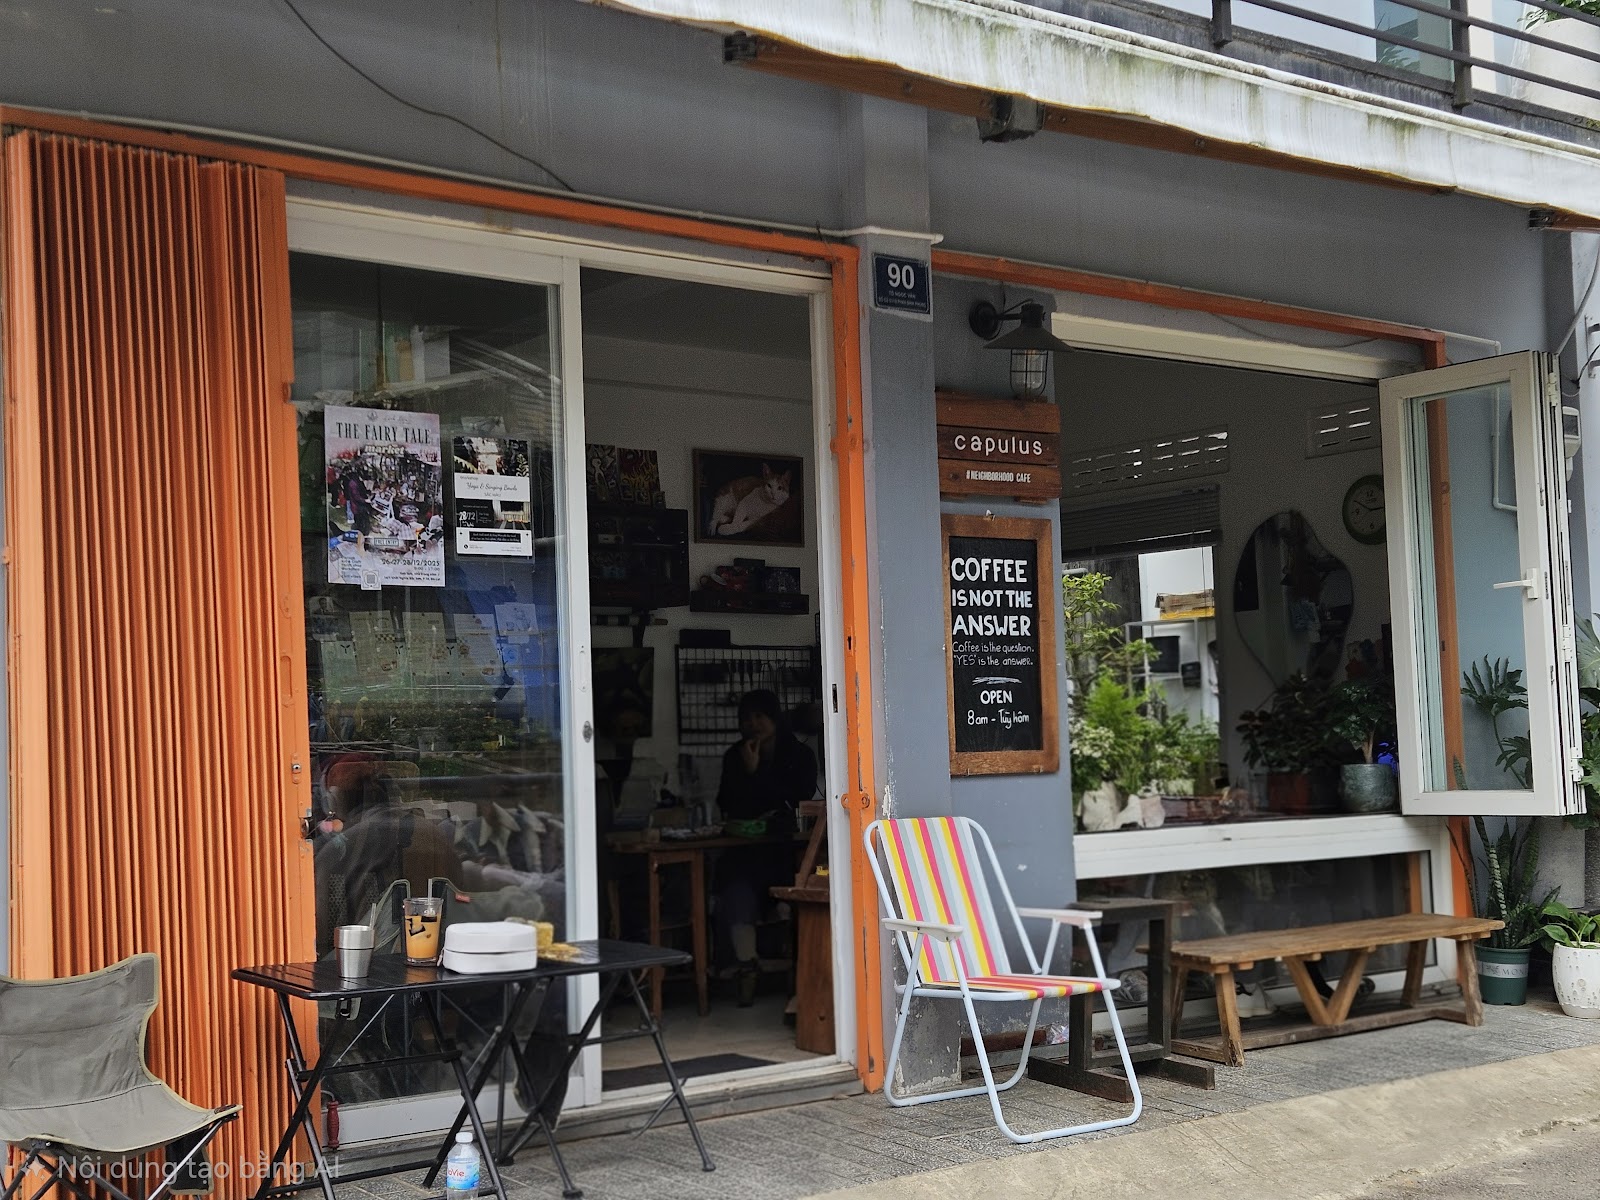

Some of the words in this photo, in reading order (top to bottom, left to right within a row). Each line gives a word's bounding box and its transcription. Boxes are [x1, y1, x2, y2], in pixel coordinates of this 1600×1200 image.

[887, 262, 915, 290] 90
[336, 422, 360, 439] THE
[365, 424, 398, 442] FAIRY
[403, 427, 432, 444] TALE
[364, 444, 405, 455] market
[954, 434, 1043, 456] capulus
[1016, 473, 1031, 483] CAFE
[951, 557, 1028, 583] COFFEE
[951, 589, 968, 607] IS
[969, 589, 1003, 608] NOT
[1005, 589, 1033, 608] THE
[952, 614, 1031, 637] ANSWER
[952, 641, 980, 653] Coffee
[981, 643, 989, 653] is
[989, 641, 1001, 653] the
[1002, 642, 1034, 655] question.
[978, 657, 986, 666] is
[987, 655, 1000, 666] the
[980, 690, 1013, 705] OPEN
[1012, 711, 1030, 723] hôm
